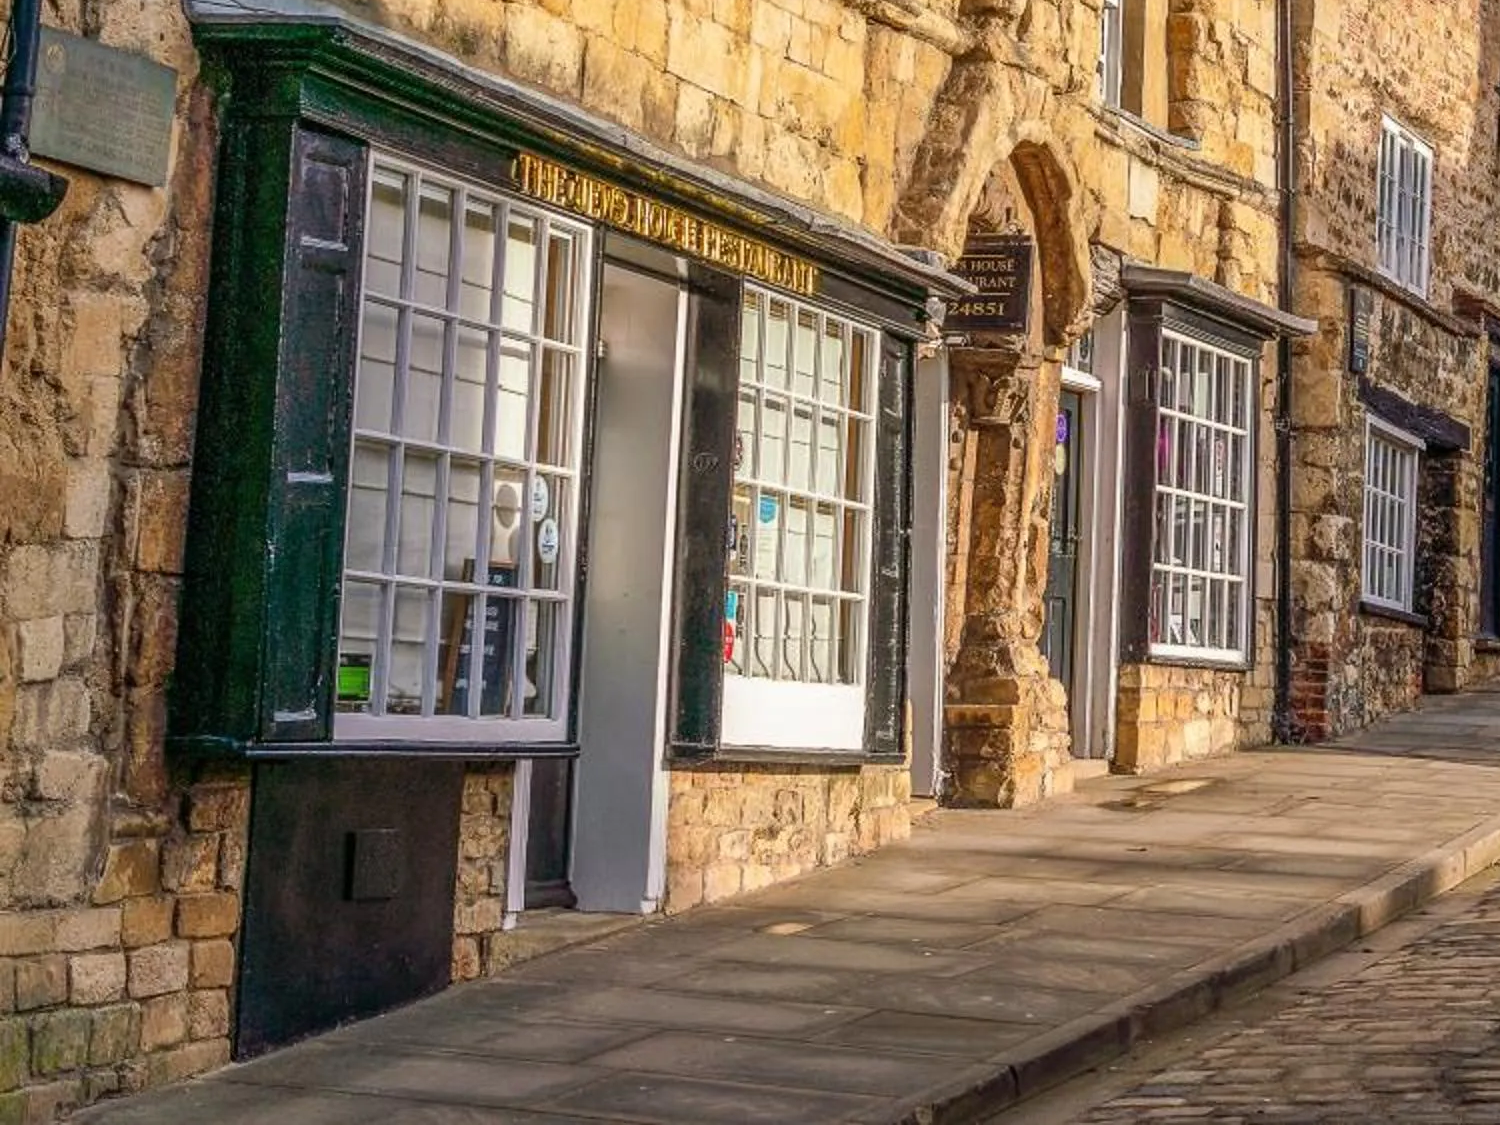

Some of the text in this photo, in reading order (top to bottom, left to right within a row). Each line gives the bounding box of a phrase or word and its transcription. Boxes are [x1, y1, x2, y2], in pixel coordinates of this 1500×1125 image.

[518, 153, 567, 208] THE
[701, 223, 820, 296] RESTAURANT
[971, 260, 1014, 271] HOUSE
[965, 277, 1016, 287] URANT
